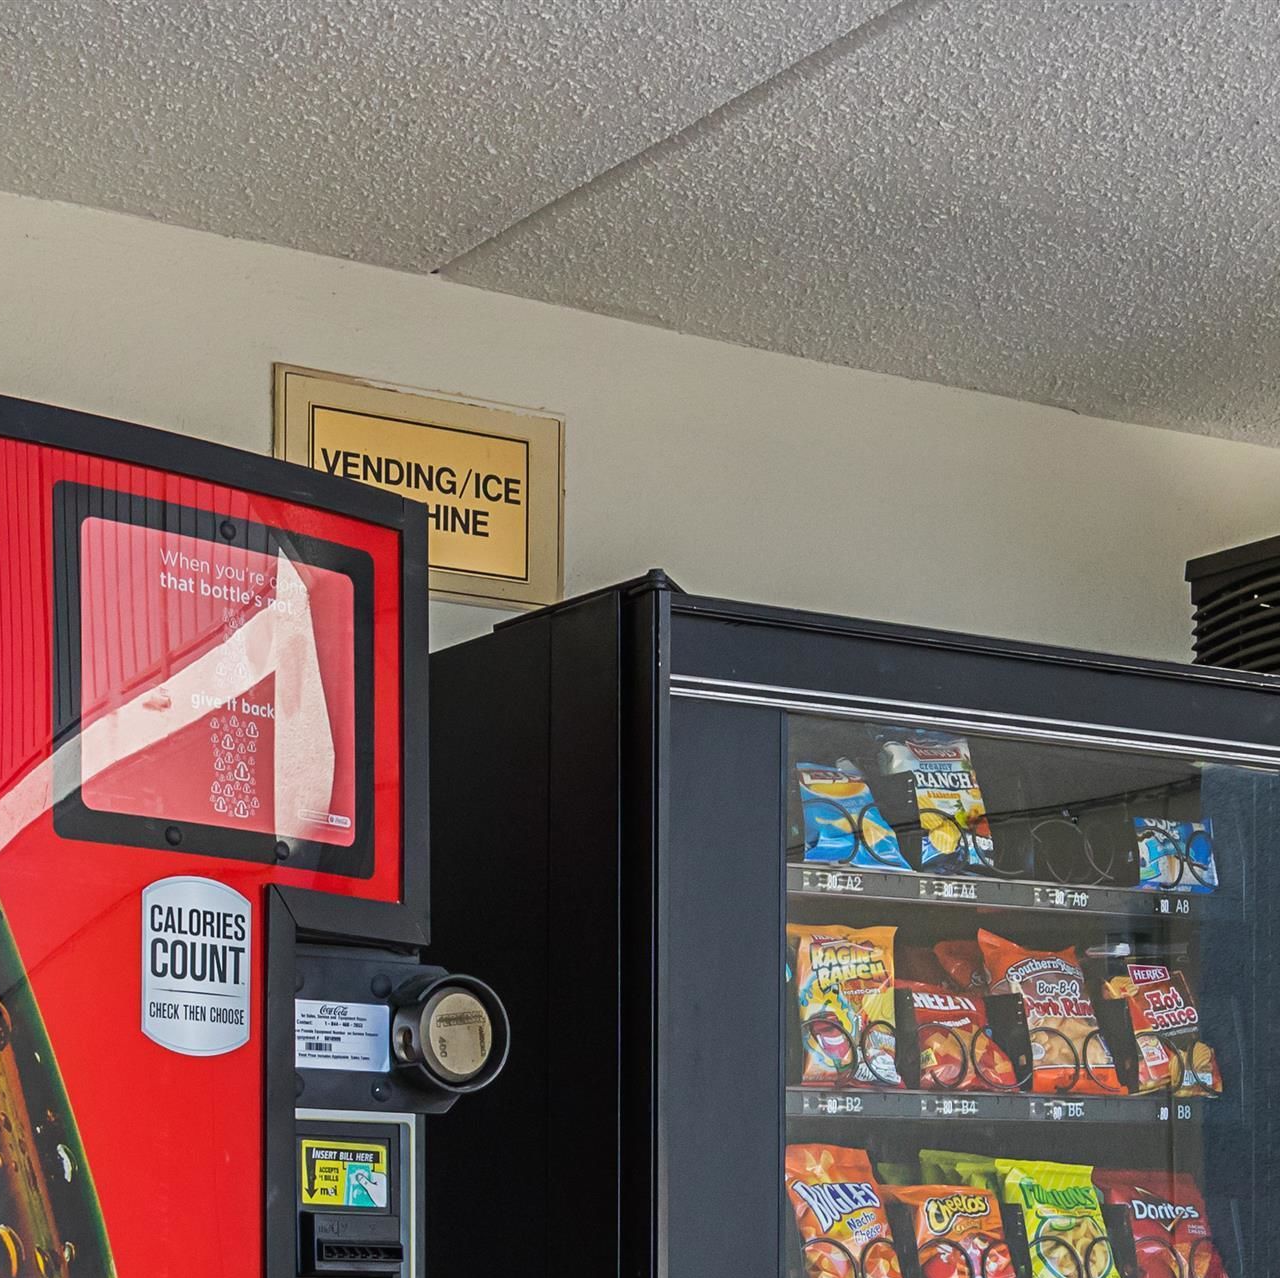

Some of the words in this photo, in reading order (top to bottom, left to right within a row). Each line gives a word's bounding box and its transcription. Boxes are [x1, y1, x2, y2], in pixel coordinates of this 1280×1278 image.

[321, 448, 521, 505] VENDING/ICE
[428, 504, 489, 537] HINE
[160, 548, 210, 574] When
[160, 572, 194, 593] that
[200, 582, 262, 608] bottle's
[914, 771, 973, 788] RANCH
[150, 904, 246, 942] CALORIES
[150, 937, 246, 985] COUNT
[1007, 959, 1059, 983] Southern
[1036, 980, 1080, 999] Bar-B-Q
[1144, 987, 1184, 1012] Hot
[149, 1002, 179, 1020] CHECK
[183, 1004, 206, 1022] THEN
[210, 1006, 245, 1026] CHOOSE
[1144, 1006, 1198, 1031] Sauce
[1177, 1106, 1191, 1119] B8
[312, 1148, 337, 1160] INSERT
[339, 1151, 353, 1160] BILL
[356, 1153, 373, 1162] HERE
[792, 1181, 881, 1233] BUGLES
[924, 1194, 991, 1236] Cheetos
[1131, 1199, 1200, 1219] Doritos
[847, 1211, 877, 1230] Nacho
